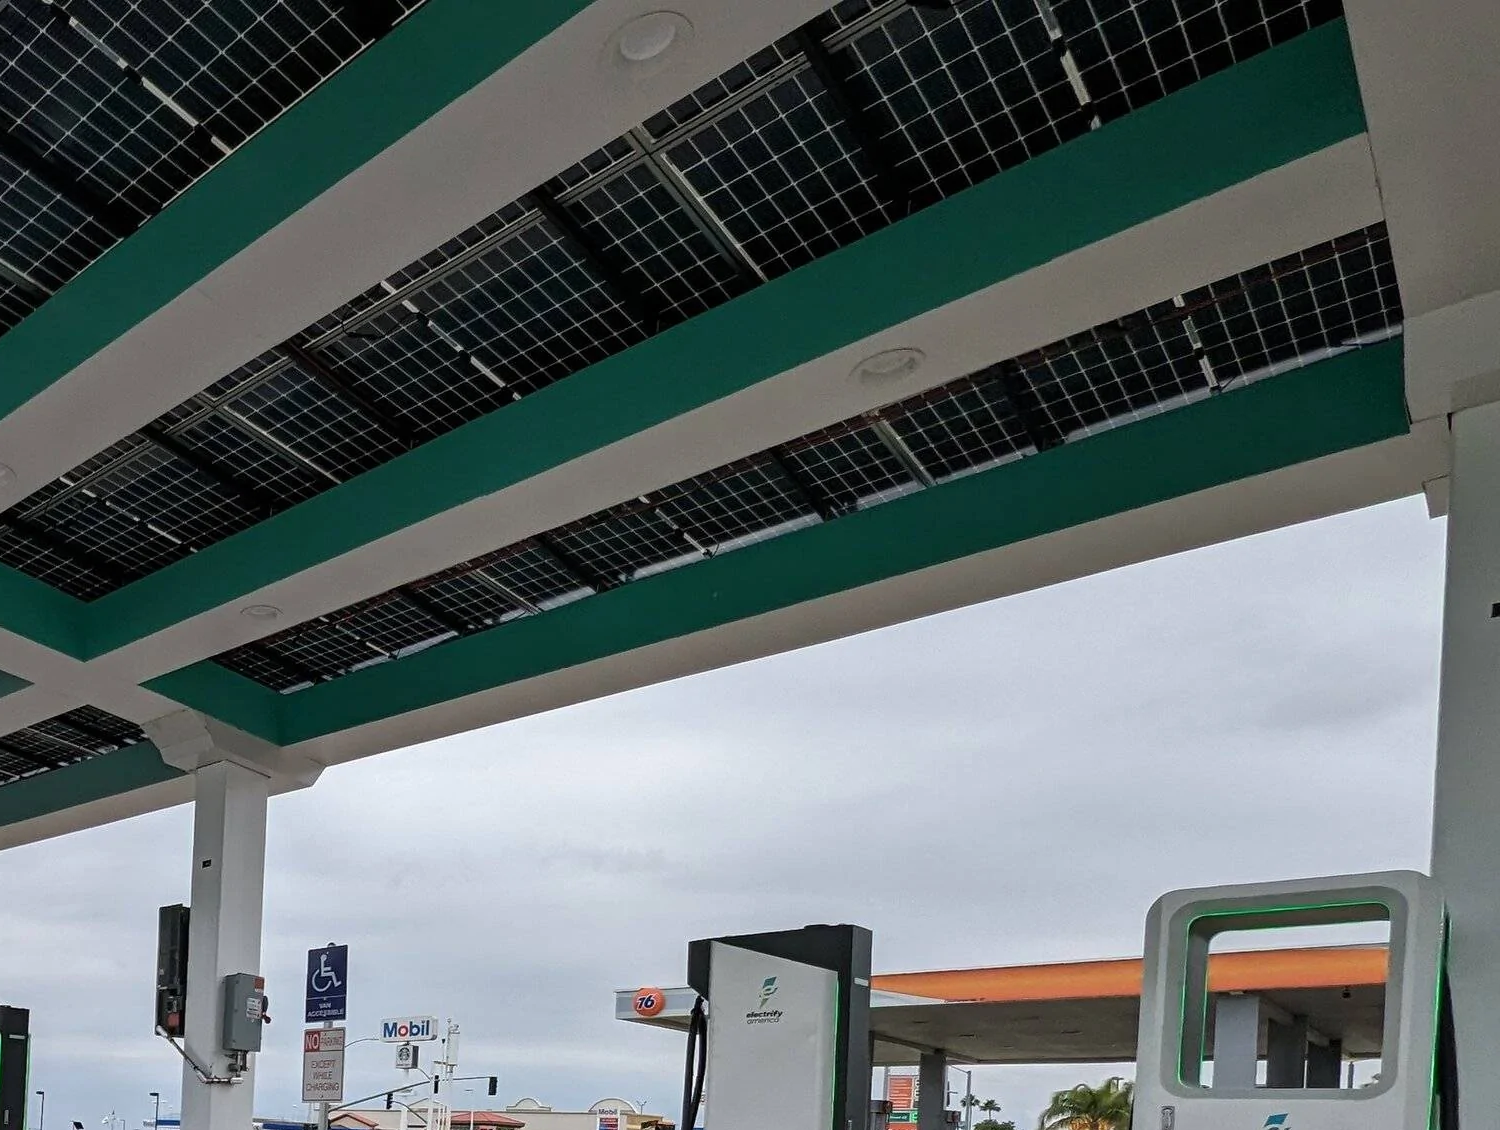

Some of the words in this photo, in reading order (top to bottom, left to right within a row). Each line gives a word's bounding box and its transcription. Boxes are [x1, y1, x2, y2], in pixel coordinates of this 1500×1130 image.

[636, 993, 657, 1010] 76
[746, 1009, 783, 1018] electrify
[746, 1016, 780, 1025] america
[383, 1019, 430, 1038] Mobil
[305, 1034, 319, 1050] NO
[310, 1059, 336, 1069] EXCEPT
[312, 1071, 332, 1080] WHILE
[305, 1082, 340, 1092] CHARGING
